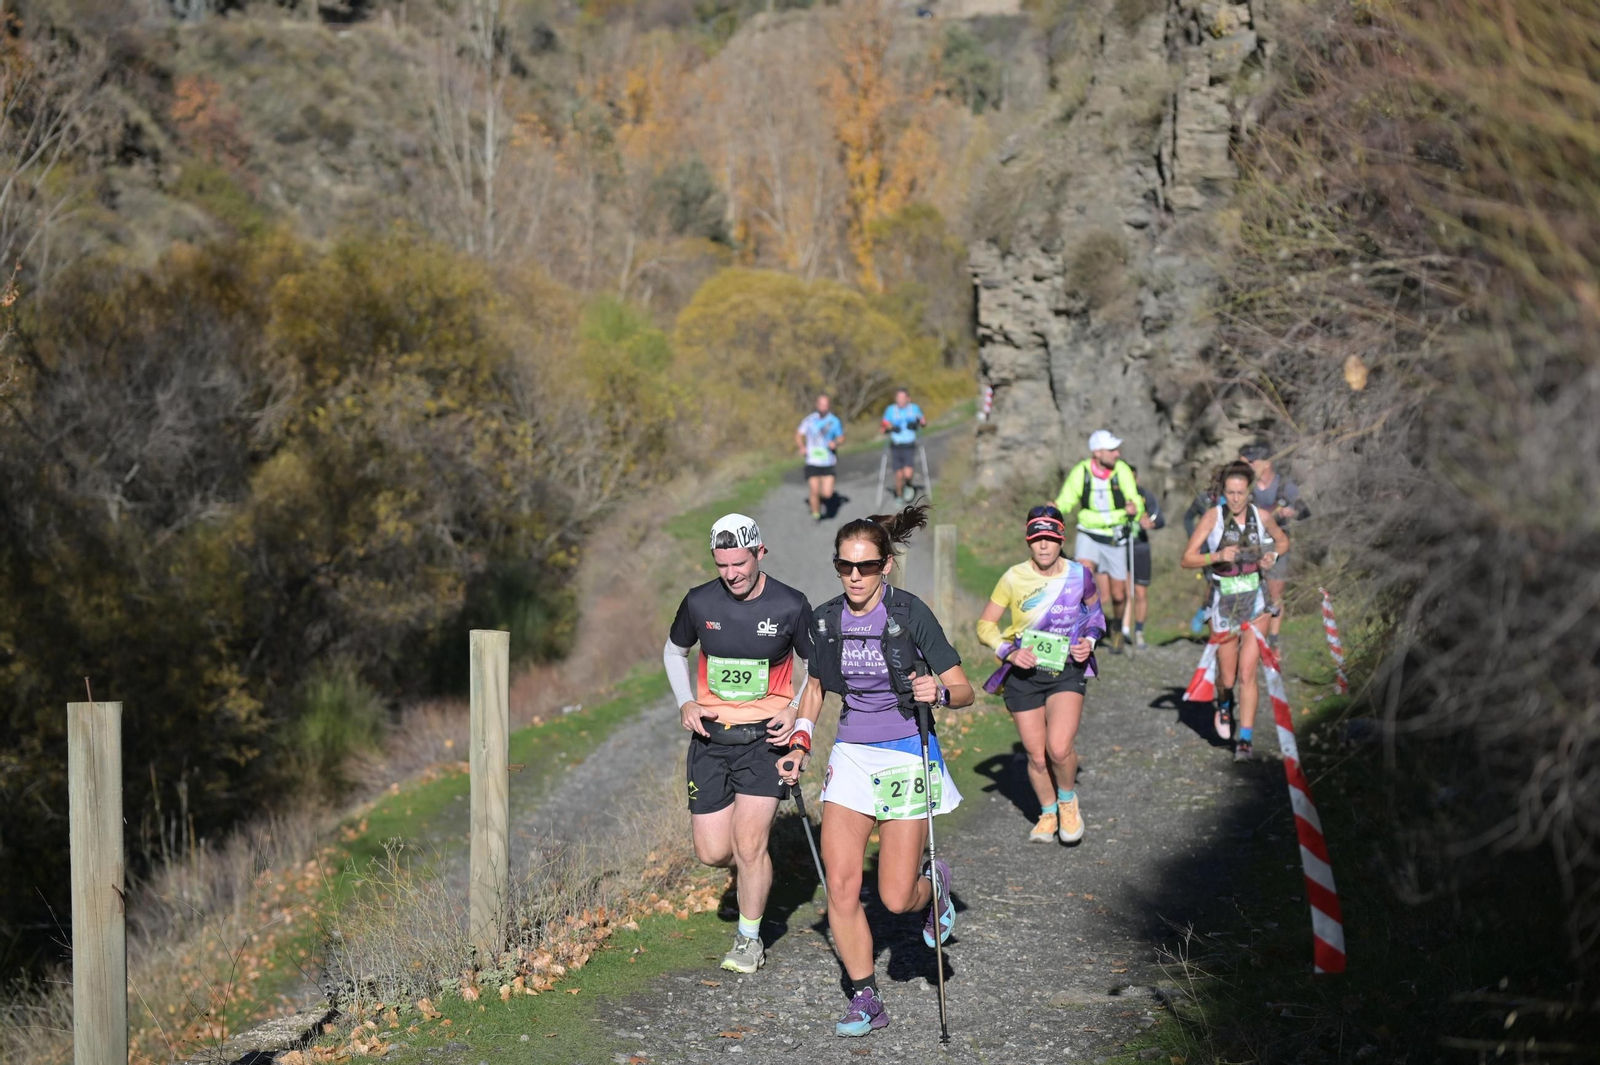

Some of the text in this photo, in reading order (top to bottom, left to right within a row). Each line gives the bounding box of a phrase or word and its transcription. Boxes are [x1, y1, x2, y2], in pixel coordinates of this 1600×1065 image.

[1037, 641, 1052, 654] 63
[721, 669, 752, 685] 239
[890, 777, 925, 798] 278
